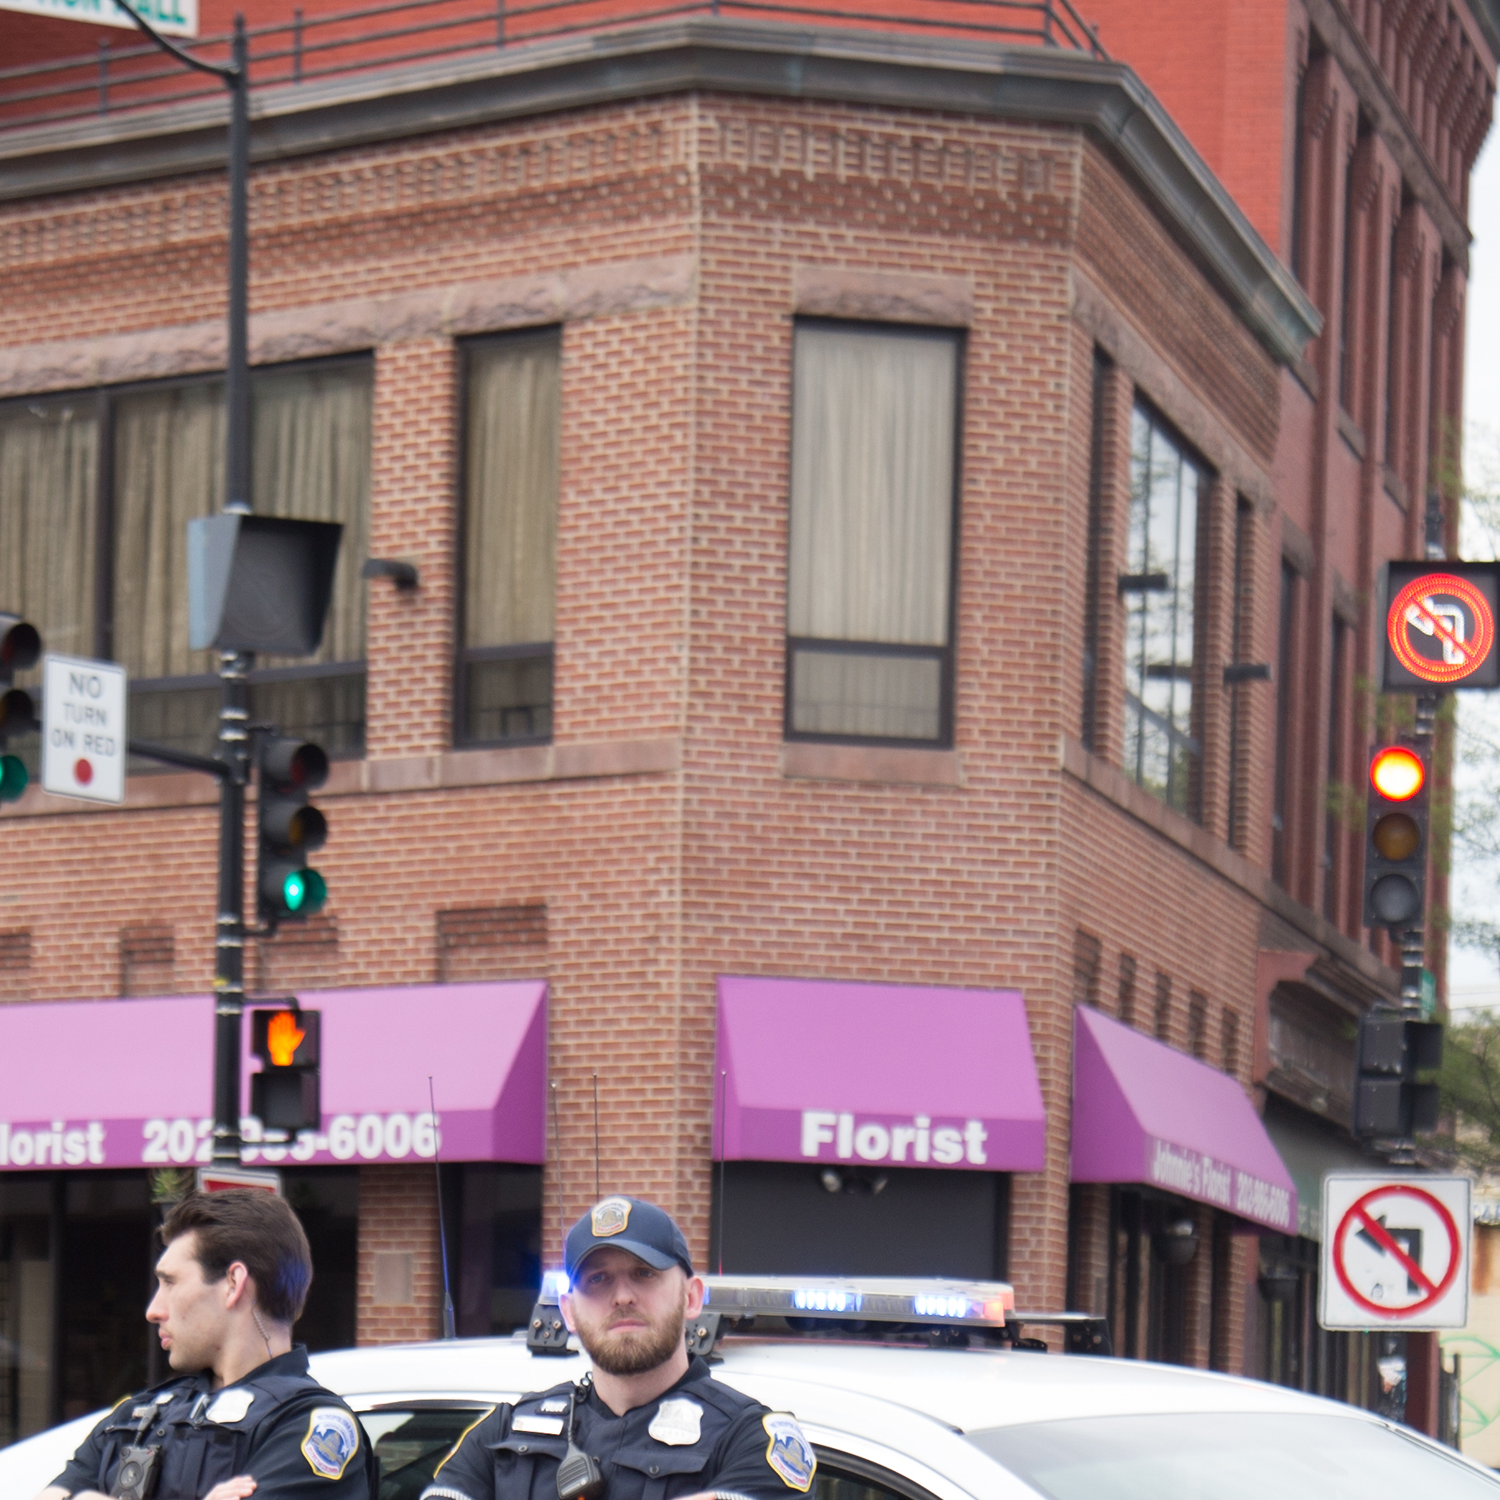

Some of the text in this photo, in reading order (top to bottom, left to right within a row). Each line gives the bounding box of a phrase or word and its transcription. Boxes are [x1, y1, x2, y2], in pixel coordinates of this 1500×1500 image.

[69, 672, 102, 699] NO
[63, 702, 107, 727] TURN
[52, 728, 115, 757] ON RED
[802, 1110, 988, 1165] Florist
